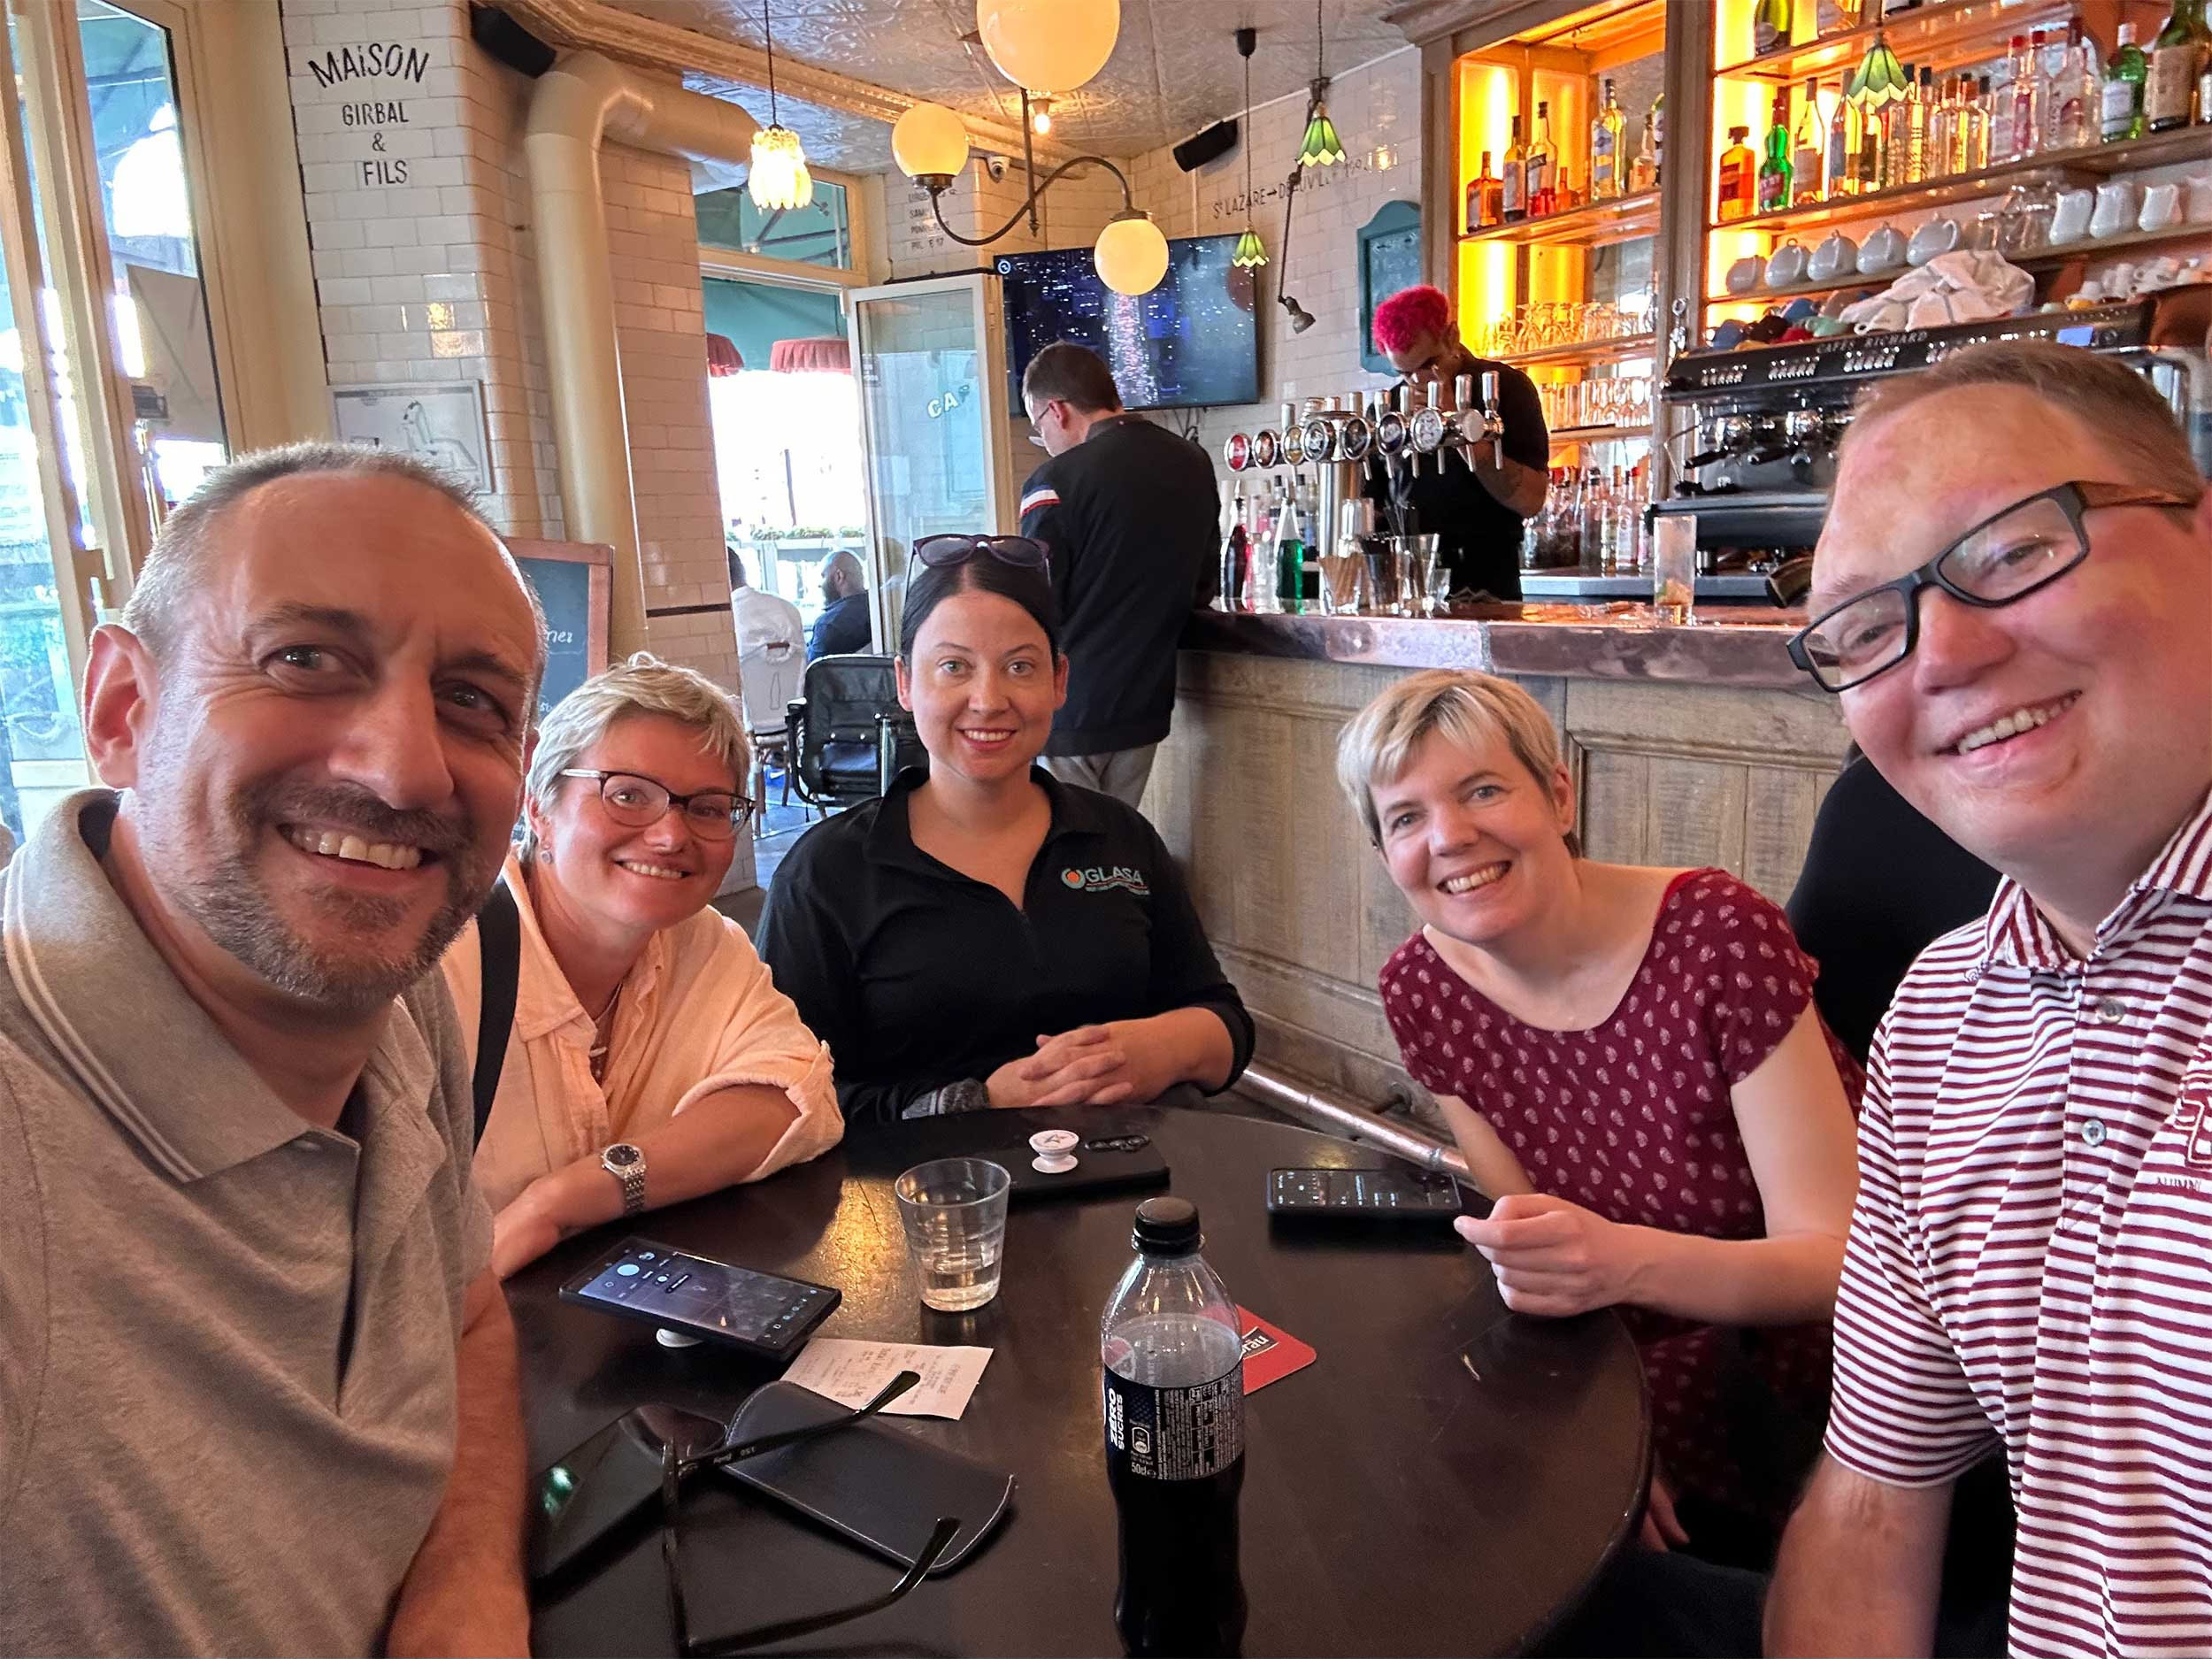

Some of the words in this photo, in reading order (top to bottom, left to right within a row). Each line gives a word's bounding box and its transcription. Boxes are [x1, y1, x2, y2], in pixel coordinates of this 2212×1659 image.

[342, 102, 409, 127] GIRBAL
[372, 132, 387, 152] &
[363, 159, 408, 186] FILS
[1116, 1394, 1125, 1451] SUCRES
